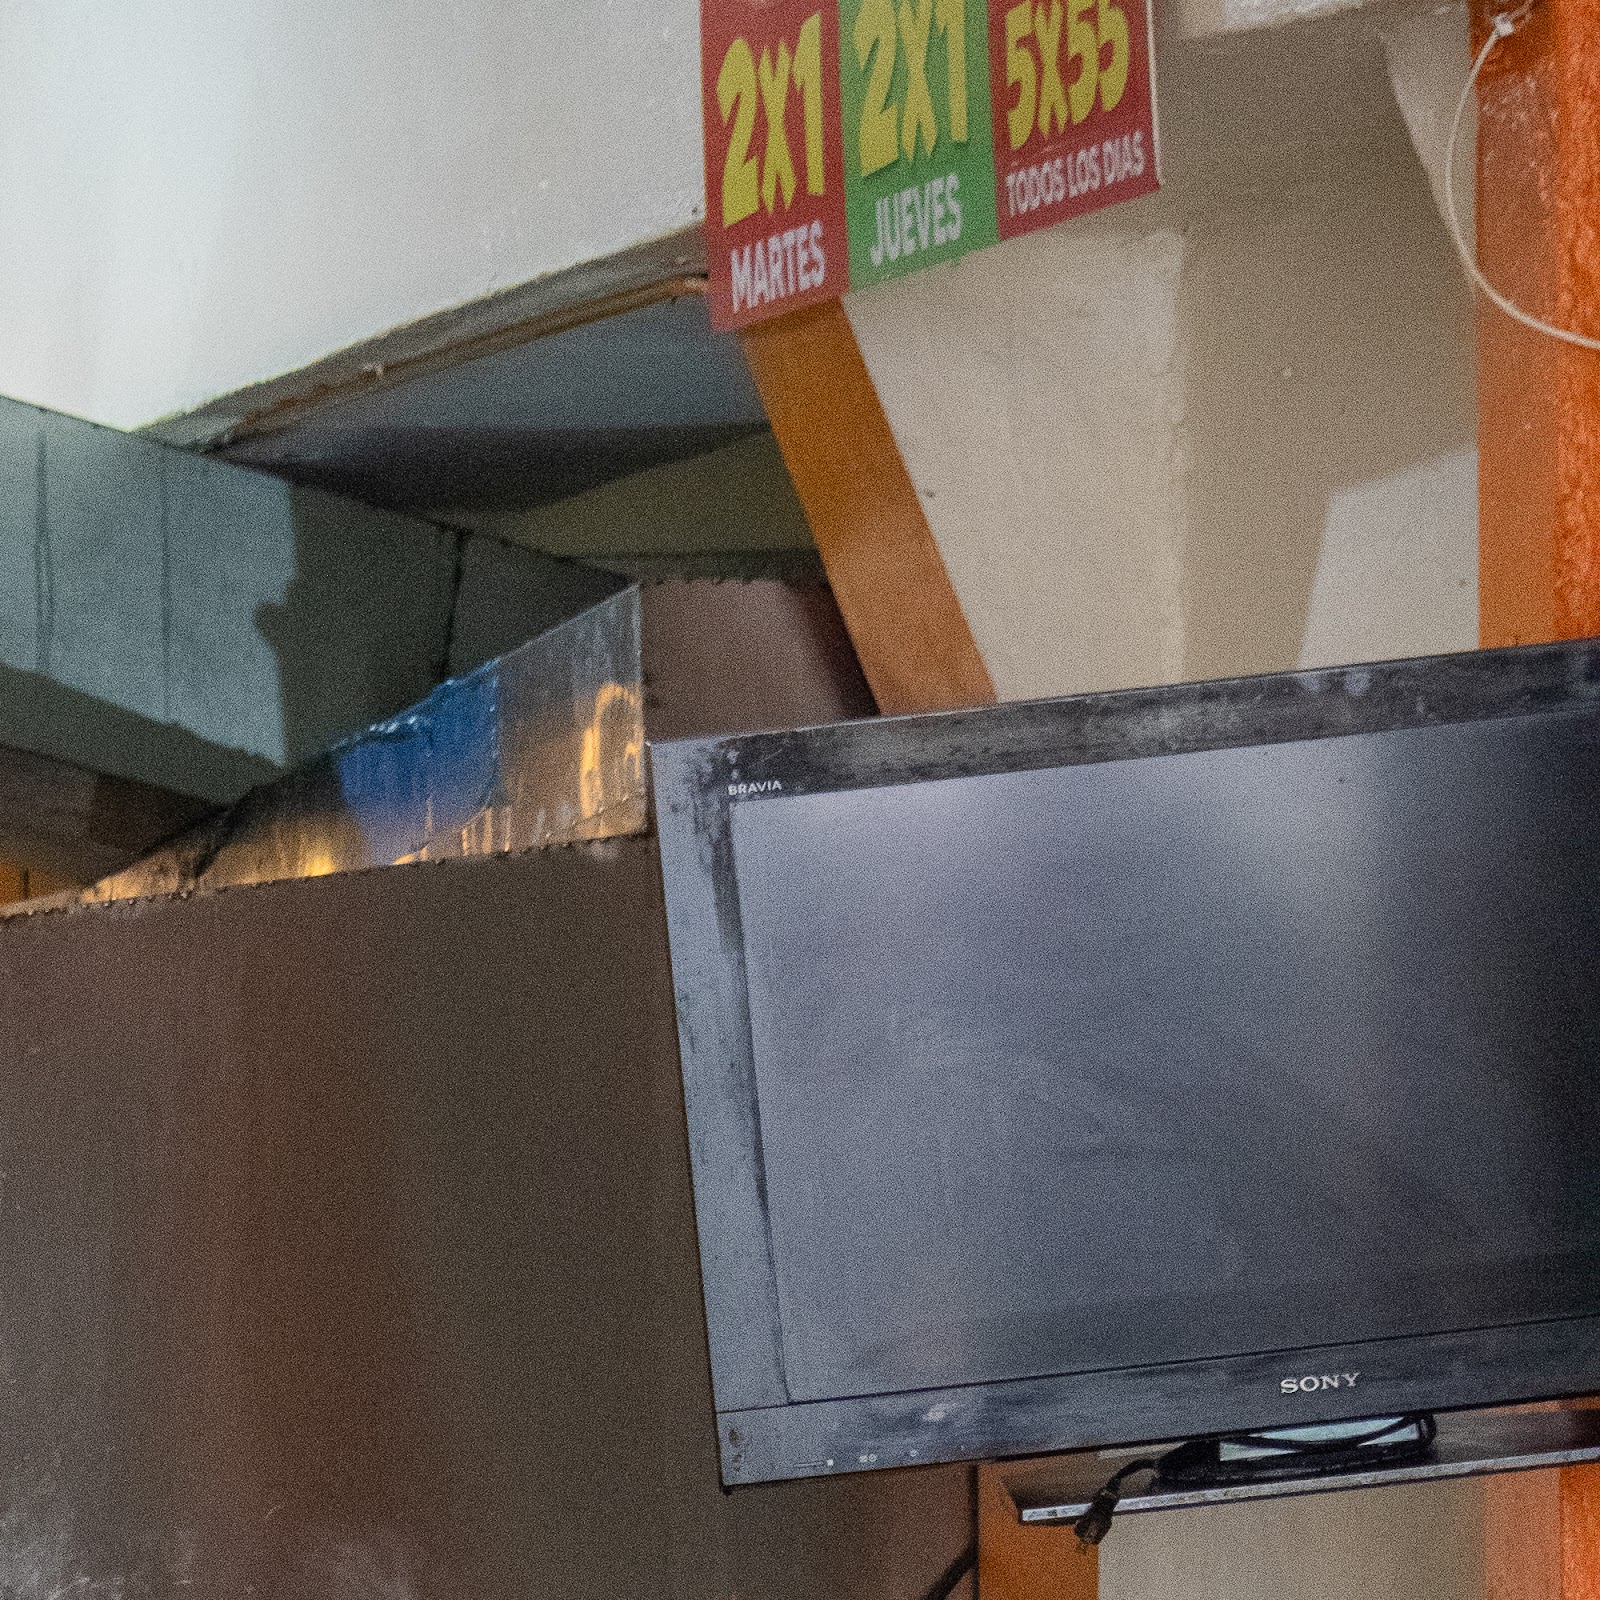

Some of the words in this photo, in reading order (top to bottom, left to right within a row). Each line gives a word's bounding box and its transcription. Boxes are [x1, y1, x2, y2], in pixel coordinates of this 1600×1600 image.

[716, 10, 824, 228] 2X1
[853, 0, 968, 177] 2X1
[870, 172, 963, 267] JUEVES
[1005, 158, 1065, 217] TODOS
[1066, 145, 1100, 198] LOS
[1103, 129, 1145, 186] DIAS
[731, 219, 825, 313] MARTES
[727, 780, 782, 796] BRAVIA
[1280, 1371, 1360, 1394] SONY
